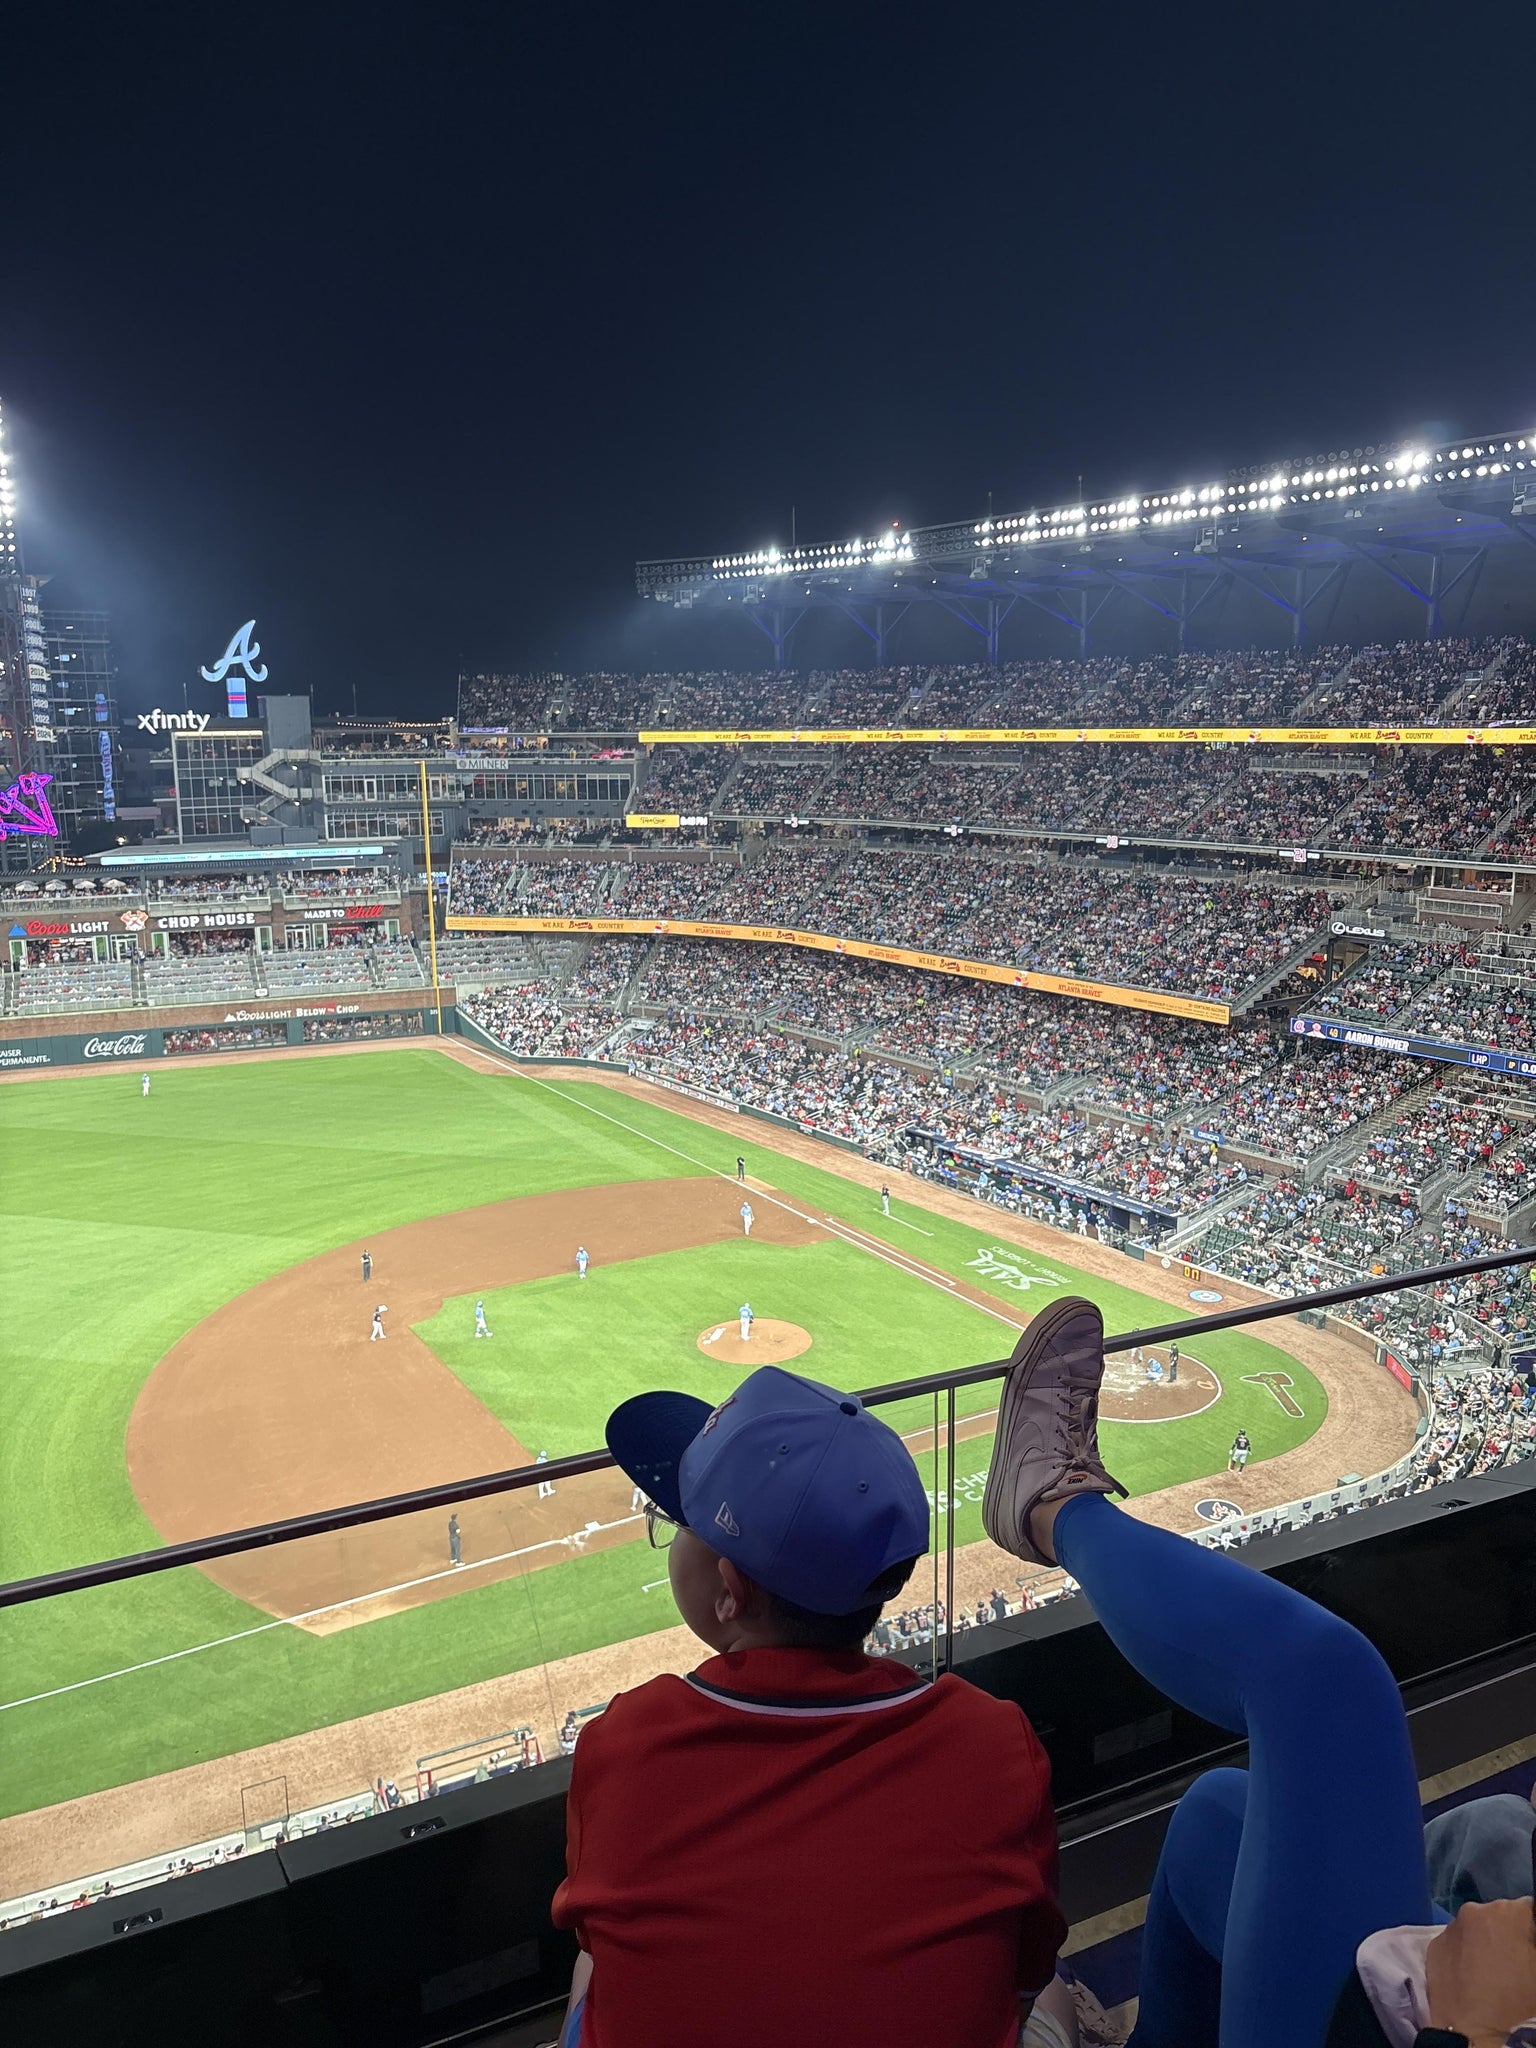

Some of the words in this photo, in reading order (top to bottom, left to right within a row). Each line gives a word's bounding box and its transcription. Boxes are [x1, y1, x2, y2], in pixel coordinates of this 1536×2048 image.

[201, 619, 268, 682] A
[30, 667, 45, 676] 2012
[32, 683, 47, 692] 2018
[33, 699, 48, 709] 2020
[34, 714, 50, 724] 2022
[138, 708, 210, 735] xfinity
[468, 760, 508, 768] MILNER
[304, 909, 331, 920] MADE
[332, 909, 345, 918] TO
[345, 904, 385, 919] Chill
[26, 920, 70, 935] Coors
[70, 921, 109, 934] LIGHT
[158, 915, 199, 929] CHOP
[204, 912, 256, 927] HOUSE
[1346, 926, 1385, 937] LEXUS
[236, 1010, 265, 1022] Coors
[265, 1010, 292, 1020] LIGHT
[296, 1007, 326, 1016] BELOW
[336, 1005, 360, 1014] CHOP
[84, 1034, 147, 1058] Coca-Cola
[1345, 1030, 1374, 1044] AARON
[1374, 1036, 1410, 1052] BUMMER
[1472, 1053, 1488, 1065] LHP
